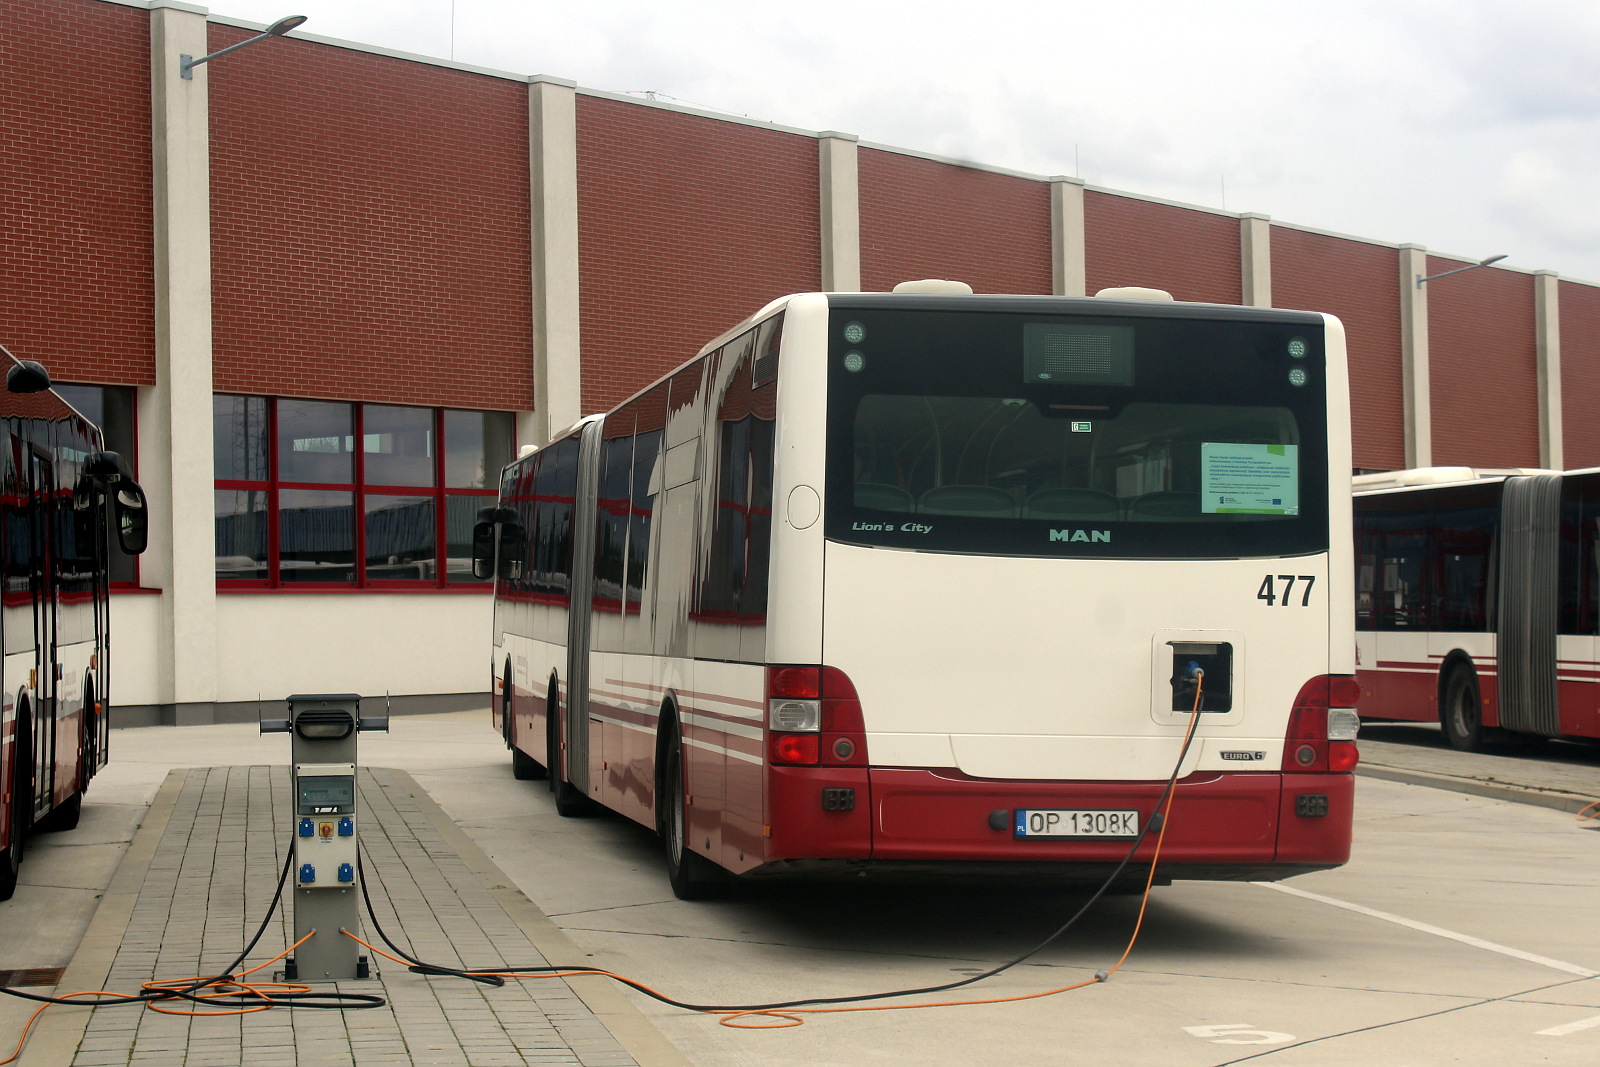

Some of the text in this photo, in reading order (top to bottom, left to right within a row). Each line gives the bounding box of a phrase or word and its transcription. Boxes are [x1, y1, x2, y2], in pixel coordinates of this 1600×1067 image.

[852, 522, 933, 534] Lion's City
[1049, 529, 1111, 543] MAN
[1257, 574, 1316, 607] 477
[1223, 751, 1263, 760] EURO 6
[1030, 812, 1135, 834] OP 1308K
[1180, 1023, 1297, 1045] 5
